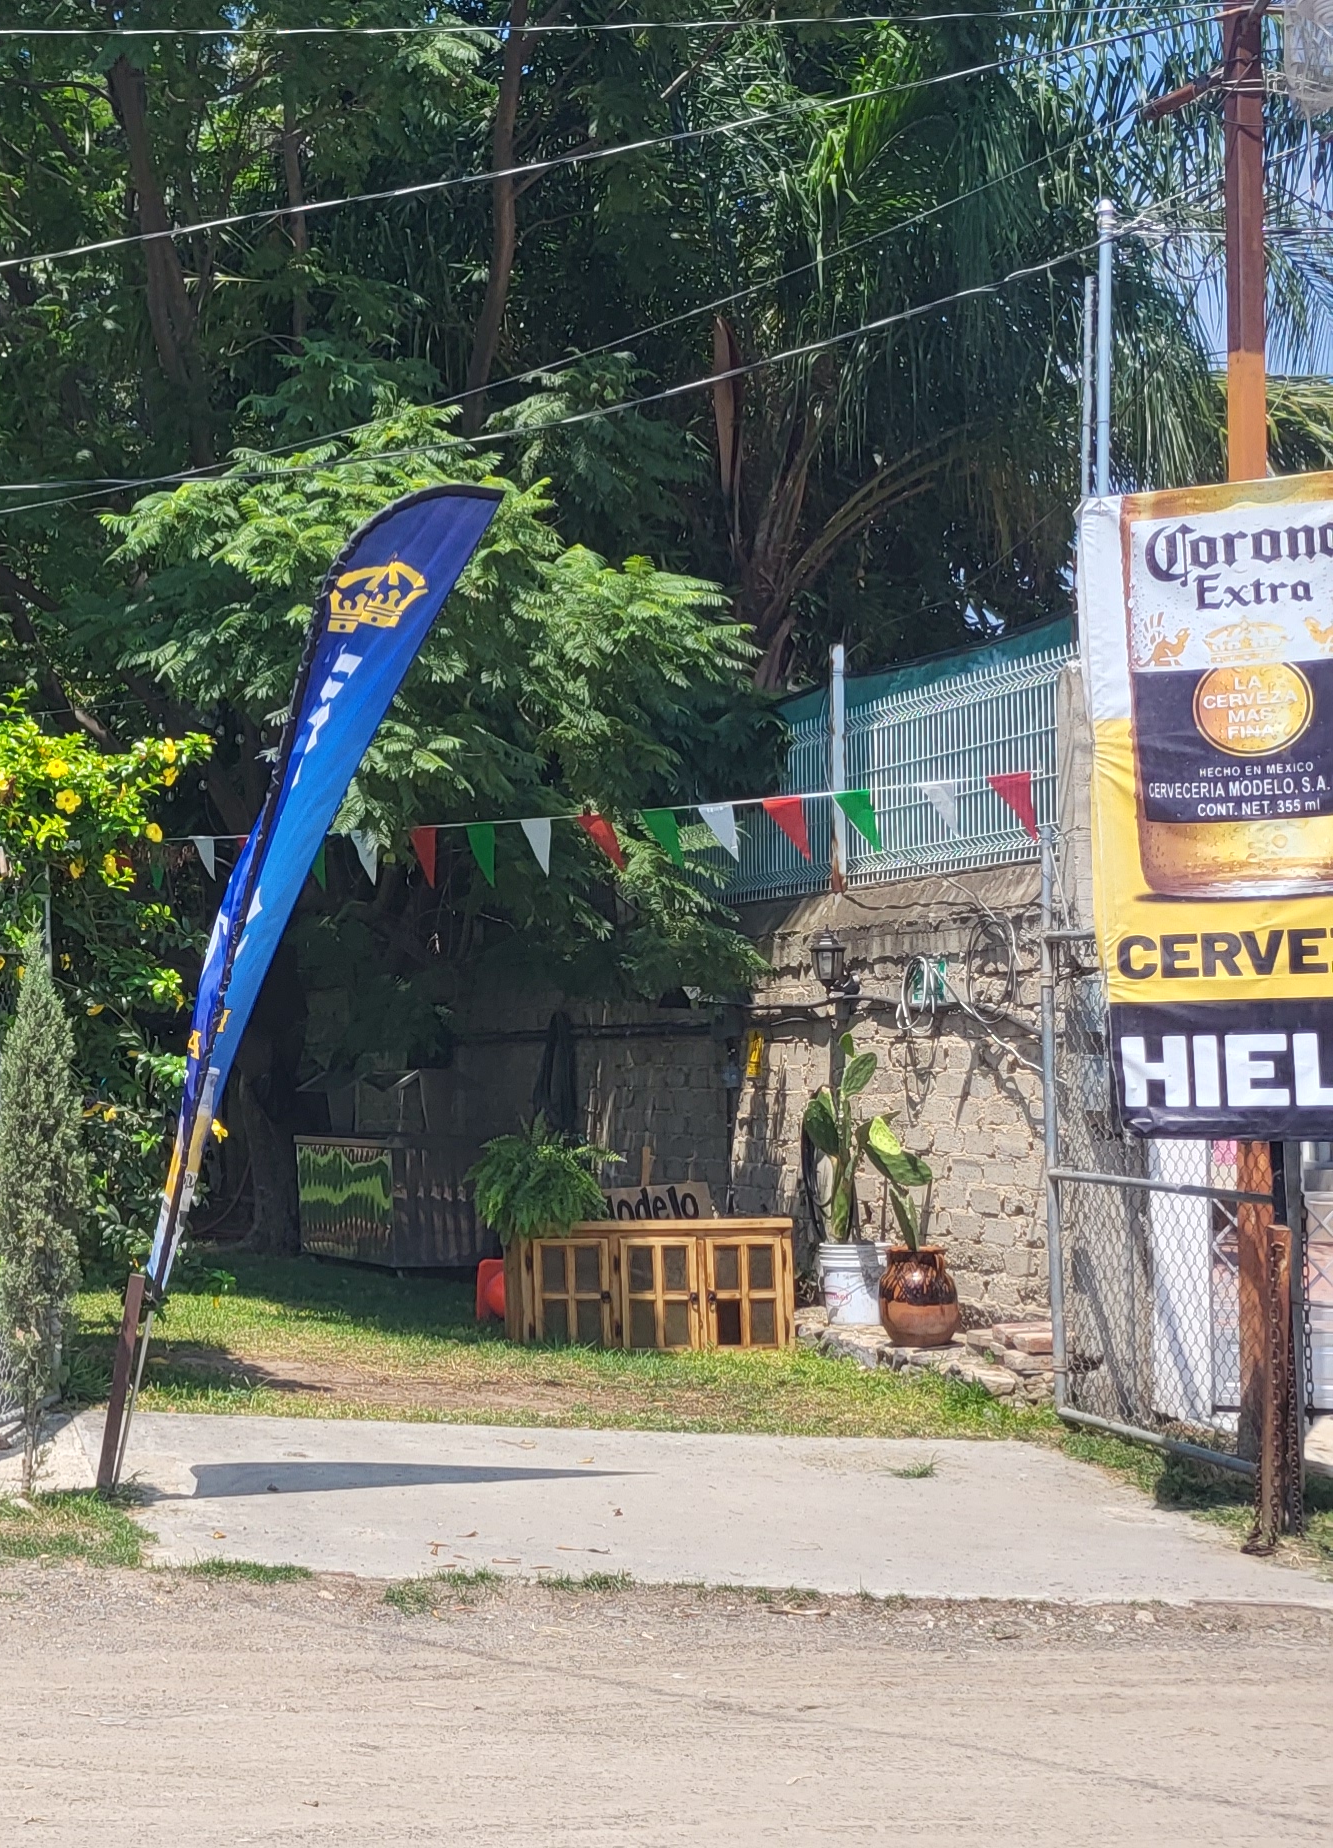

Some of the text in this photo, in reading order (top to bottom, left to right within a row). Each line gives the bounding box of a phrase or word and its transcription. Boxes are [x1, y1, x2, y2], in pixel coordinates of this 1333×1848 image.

[1193, 572, 1314, 611] Extra
[1234, 675, 1261, 691] LA
[1203, 689, 1298, 709] CERVEZA
[1228, 707, 1274, 724] MAS
[1227, 724, 1275, 740] FINA
[1199, 761, 1314, 778] HECHO EN MEXICO
[1148, 781, 1226, 799] CERVECERIA
[1229, 777, 1299, 798] MODELO,
[1197, 797, 1321, 817] CONT. NET. 355 ml
[1116, 927, 1333, 980] CERVE
[606, 1185, 700, 1220] odelo
